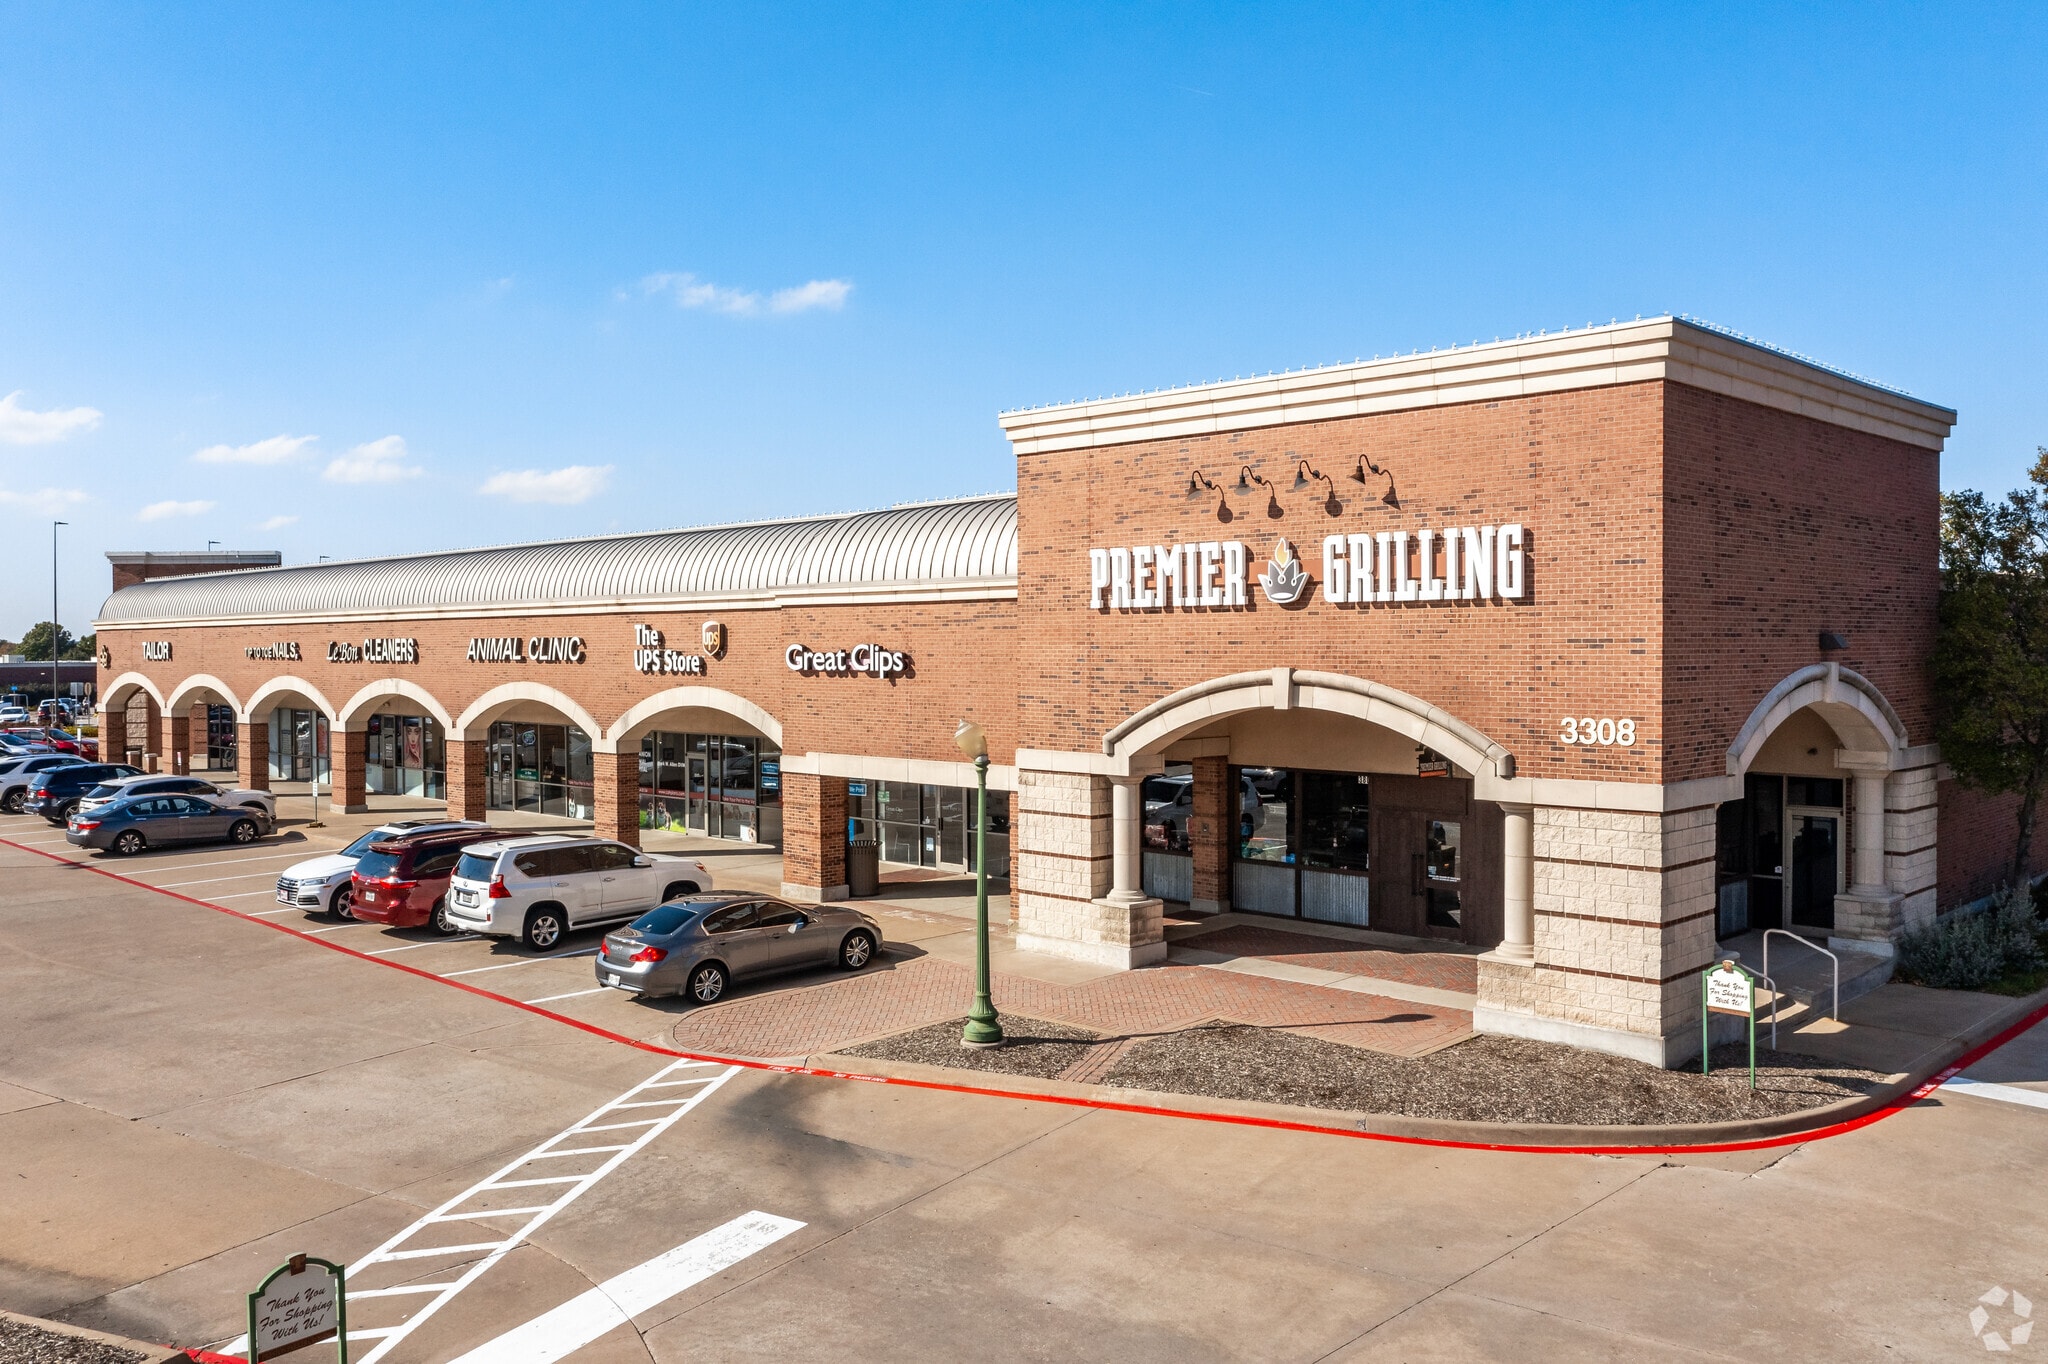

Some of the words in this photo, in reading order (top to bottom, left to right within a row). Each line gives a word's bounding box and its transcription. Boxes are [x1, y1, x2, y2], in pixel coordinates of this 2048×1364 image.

[1089, 541, 1248, 608] PREMIER
[1323, 523, 1525, 603] GRILLING
[634, 624, 659, 646] The
[703, 631, 719, 650] ups
[142, 641, 169, 660] TAILOR
[363, 637, 414, 661] CLEANERS
[466, 637, 522, 661] ANIMAL
[528, 636, 582, 661] CLINIC
[634, 649, 660, 671] UPS
[663, 651, 700, 672] Store
[785, 643, 847, 671] Great
[850, 643, 904, 679] Clips
[1560, 717, 1636, 747] 3308
[1713, 980, 1730, 988] Thank
[1722, 989, 1748, 1000] Shopping
[266, 1292, 300, 1312] Thank
[304, 1288, 326, 1302] You
[260, 1316, 280, 1332] For
[284, 1300, 333, 1322] Shopping
[271, 1322, 299, 1341] With
[303, 1314, 325, 1330] Us!
